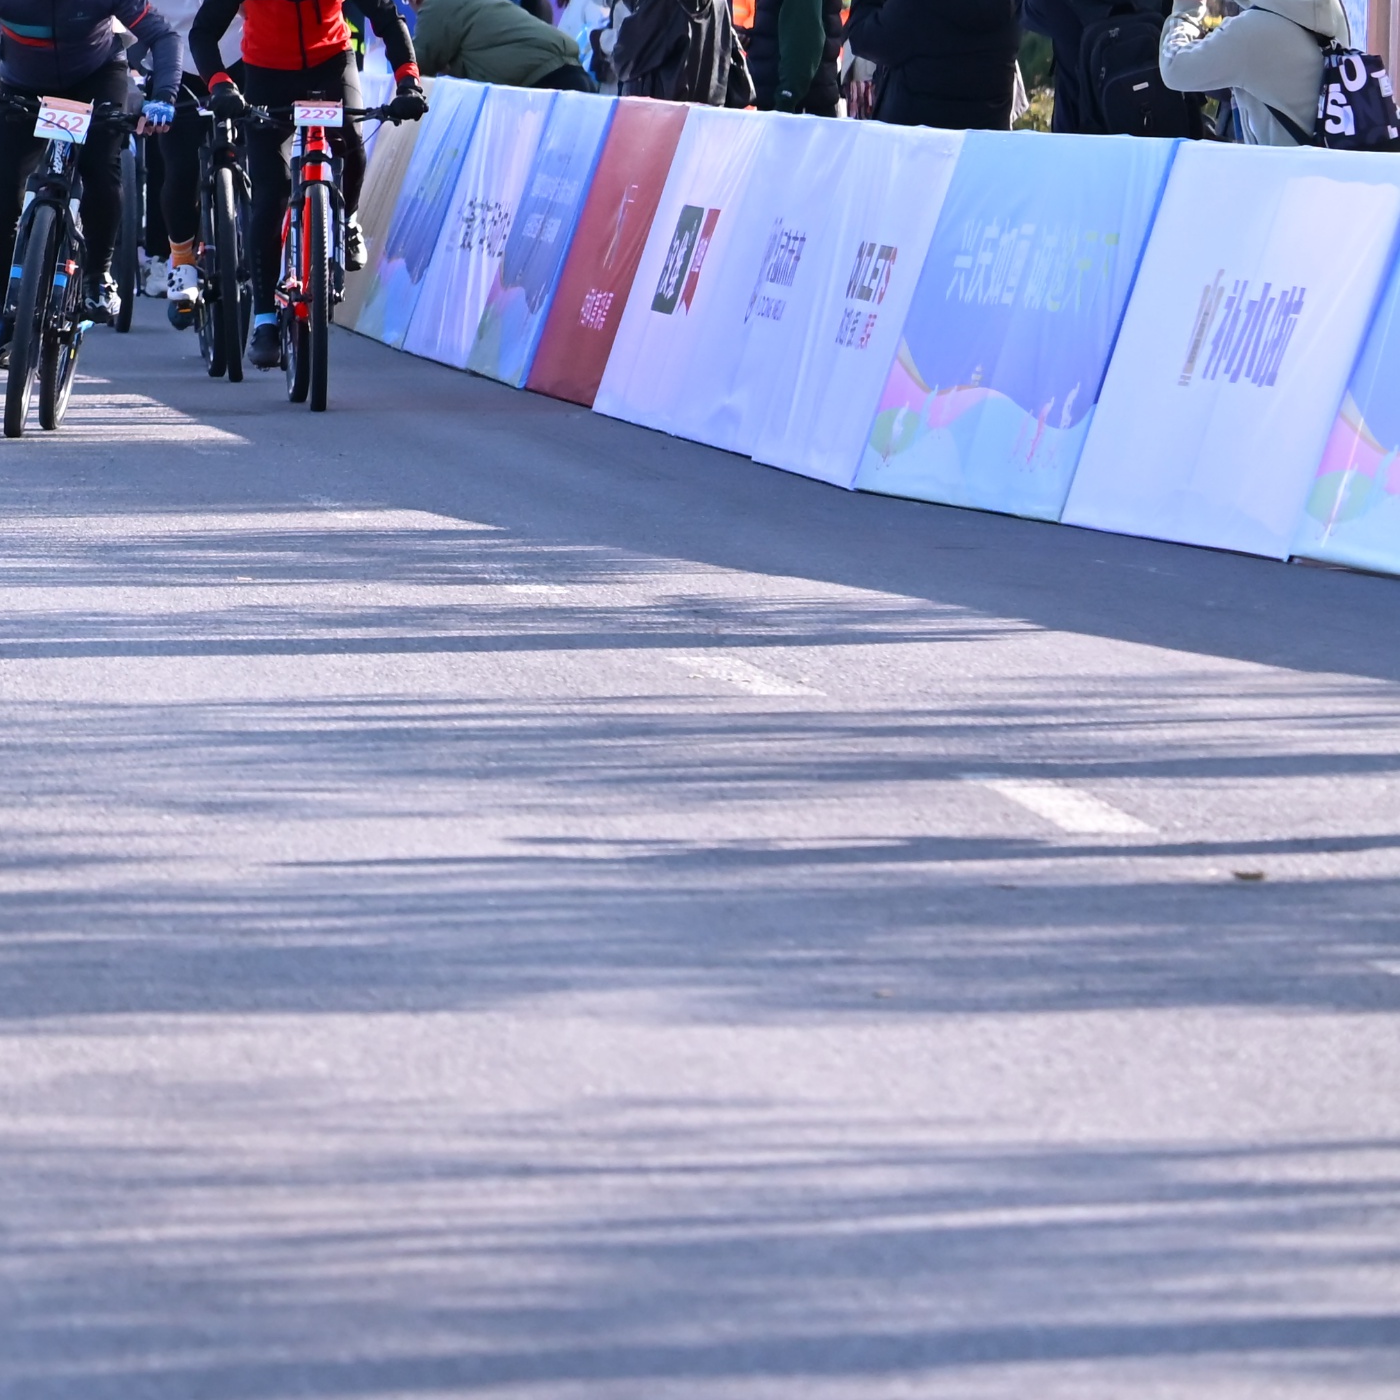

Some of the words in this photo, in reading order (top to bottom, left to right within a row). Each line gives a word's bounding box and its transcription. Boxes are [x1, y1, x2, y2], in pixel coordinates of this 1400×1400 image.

[41, 112, 85, 133] 262
[299, 108, 338, 120] 229
[1202, 280, 1307, 387] 补水啦
